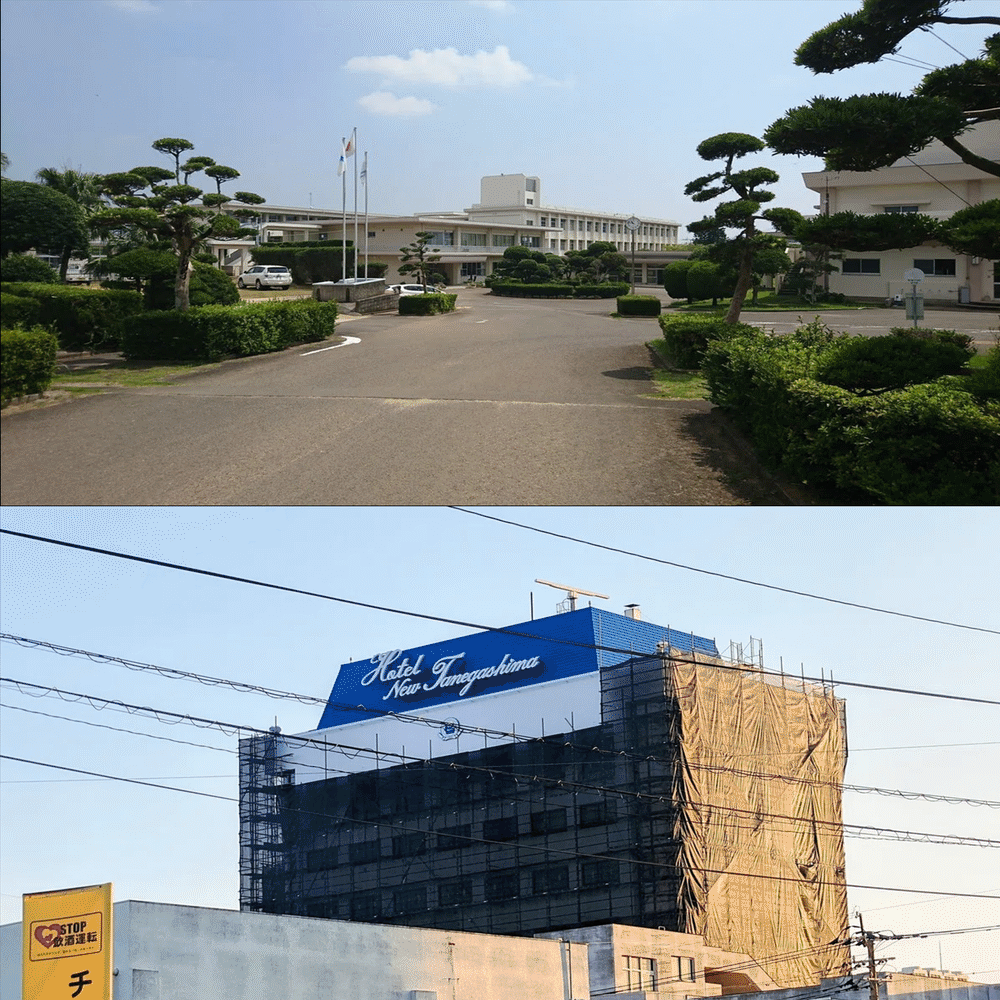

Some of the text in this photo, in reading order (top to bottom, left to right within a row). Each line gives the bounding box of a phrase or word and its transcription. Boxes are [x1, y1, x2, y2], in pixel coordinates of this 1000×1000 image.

[360, 649, 425, 686] Hotel
[382, 652, 540, 700] New Tanegashima
[53, 931, 98, 948] 飲酒運転
[60, 921, 87, 935] STOP
[69, 969, 92, 998] チ
